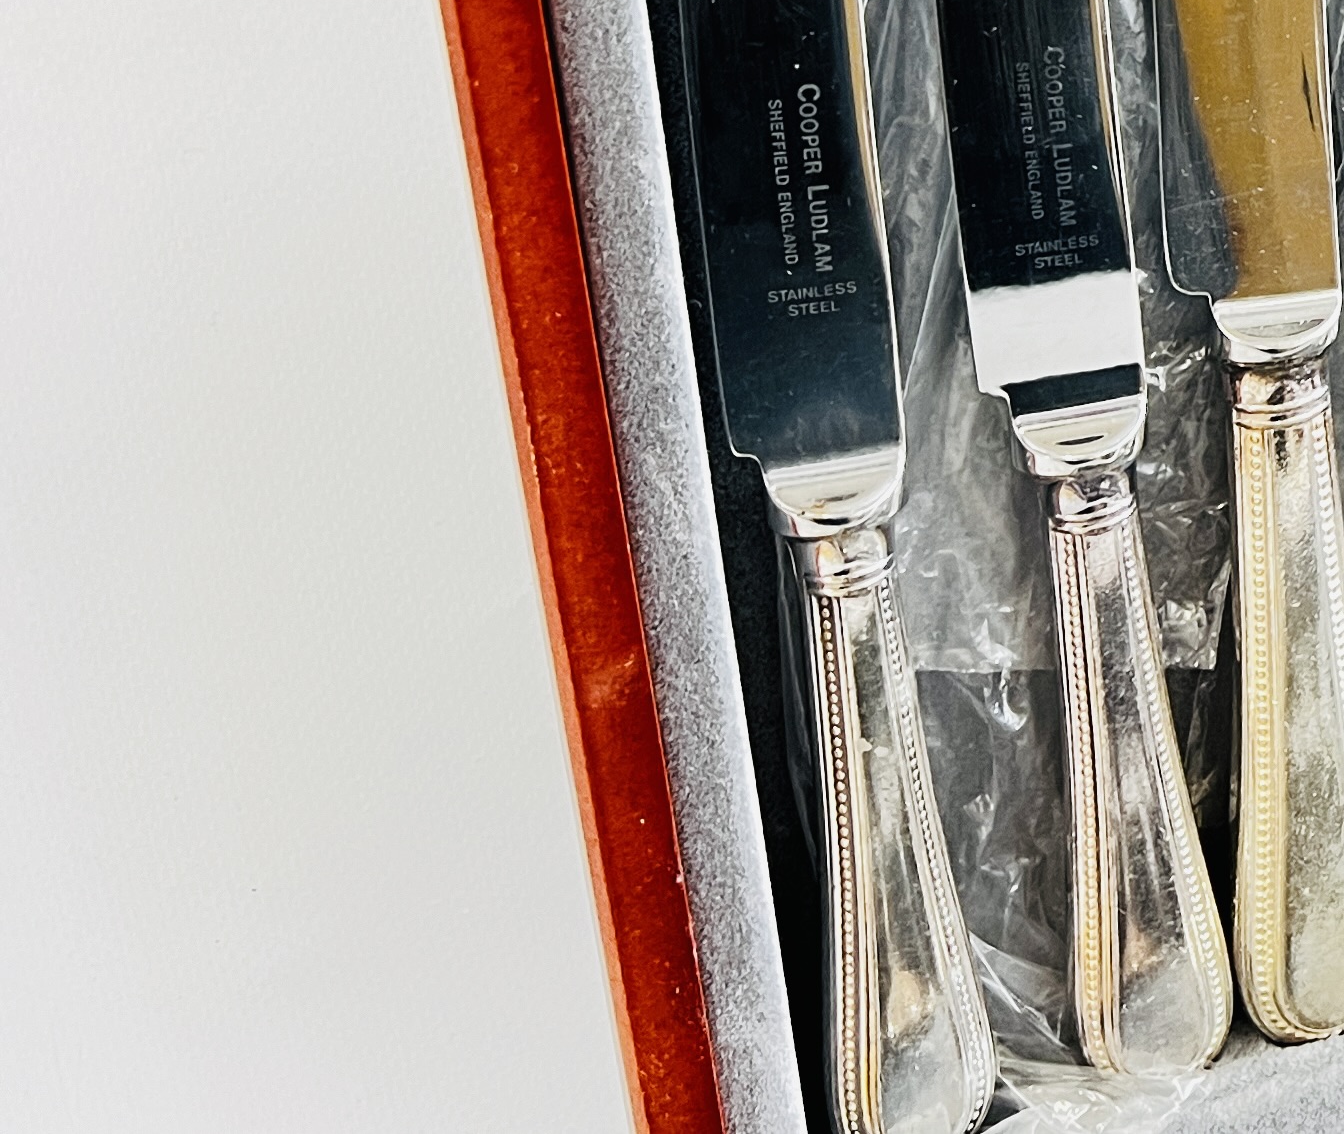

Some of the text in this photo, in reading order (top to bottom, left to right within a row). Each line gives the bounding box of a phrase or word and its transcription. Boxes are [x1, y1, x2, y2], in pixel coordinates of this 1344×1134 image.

[768, 99, 799, 265] SHEFFIELD ENGLAND
[797, 83, 833, 272] COOPER LUDLAM
[1016, 62, 1045, 221] SHEFFIELD ENGLAND
[1043, 46, 1077, 227] COOPER LUDLAM
[1015, 234, 1099, 257] STAINLESS
[1034, 252, 1084, 269] STEEL
[767, 281, 857, 304] STAINLESS
[788, 300, 840, 317] STEEL
